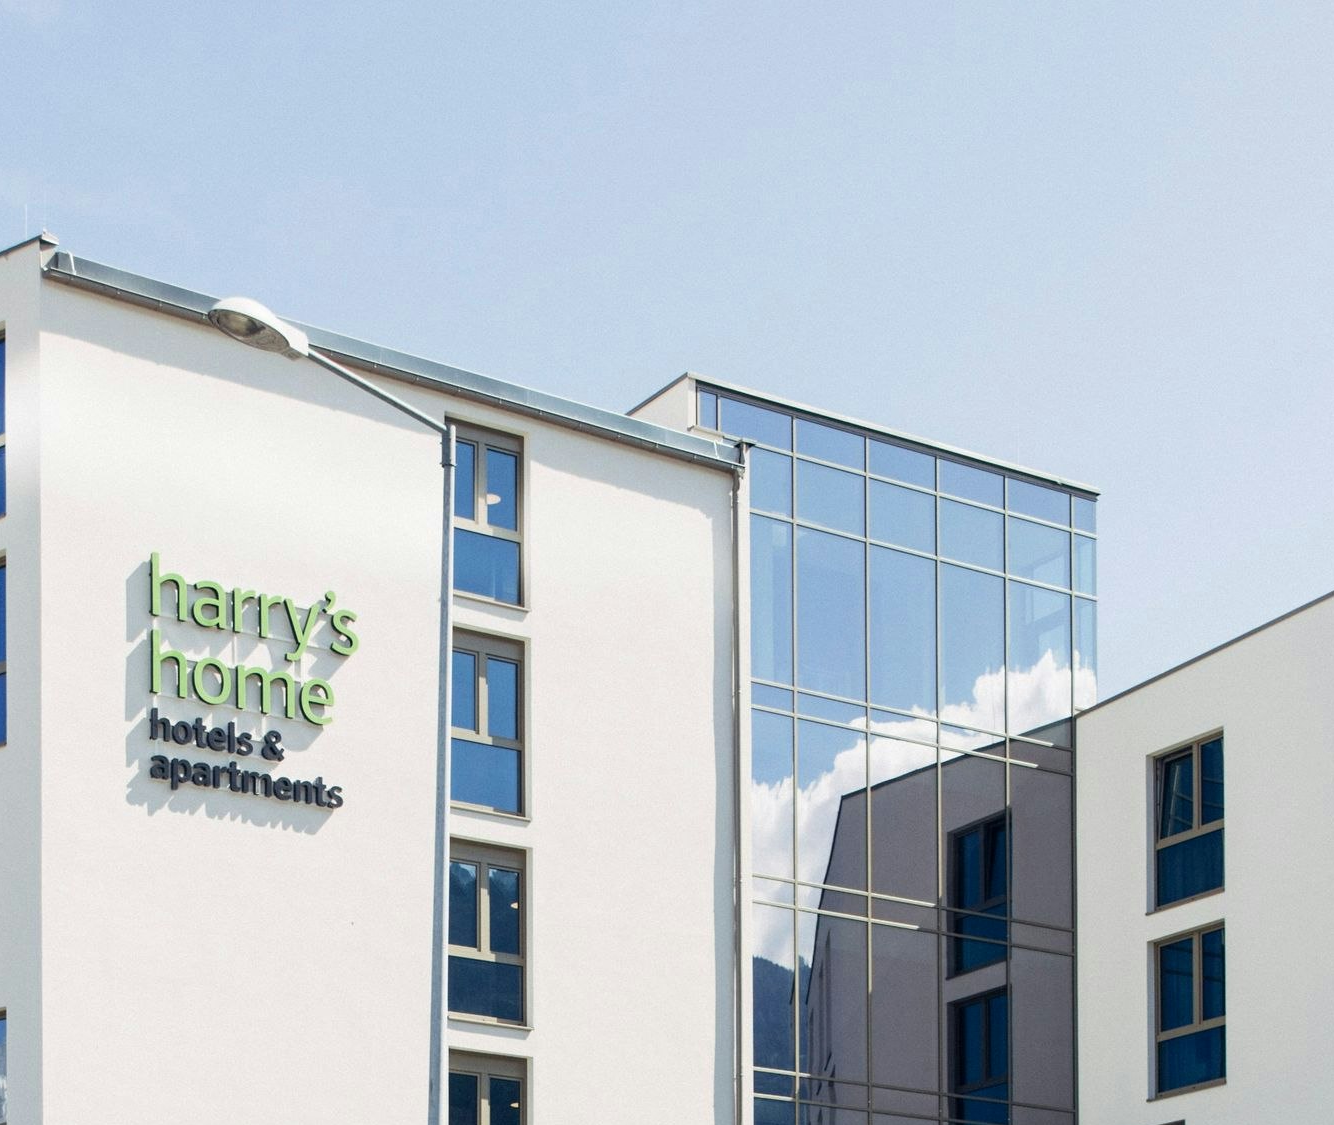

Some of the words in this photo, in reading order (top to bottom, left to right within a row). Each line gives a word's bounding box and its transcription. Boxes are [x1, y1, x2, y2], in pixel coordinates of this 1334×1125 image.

[150, 552, 359, 661] harry's
[150, 628, 334, 725] home
[150, 708, 254, 756] hotels
[261, 730, 285, 761] &
[150, 754, 343, 809] apartments
